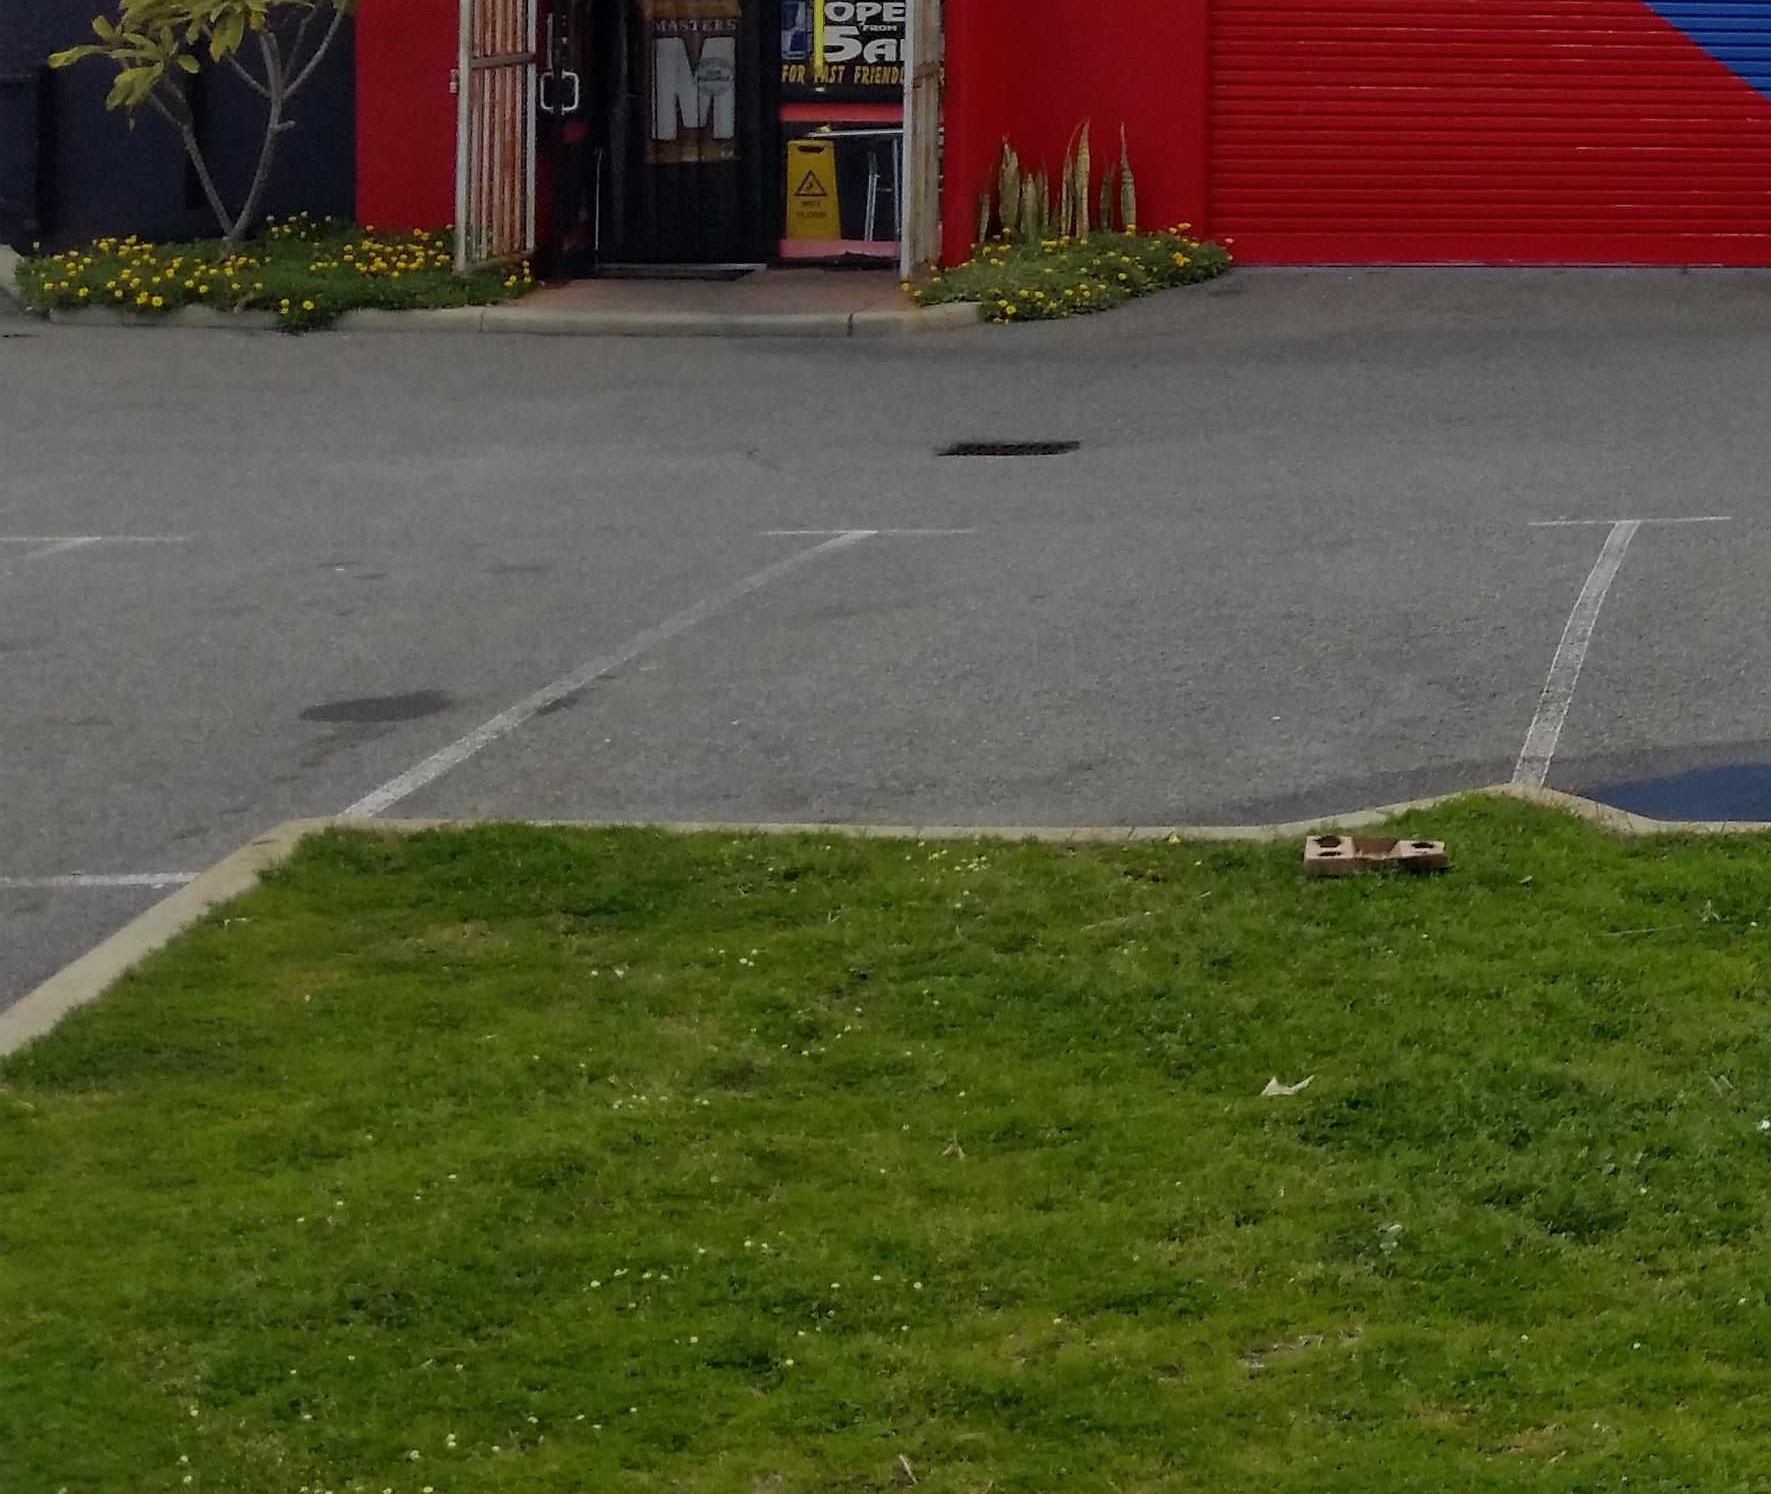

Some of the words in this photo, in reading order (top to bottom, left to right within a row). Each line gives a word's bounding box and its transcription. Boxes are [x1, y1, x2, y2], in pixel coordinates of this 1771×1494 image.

[824, 2, 907, 25] OPE
[654, 18, 738, 32] MASTERS
[863, 24, 898, 32] FROM
[823, 26, 906, 63] 5A
[781, 64, 806, 84] FOR
